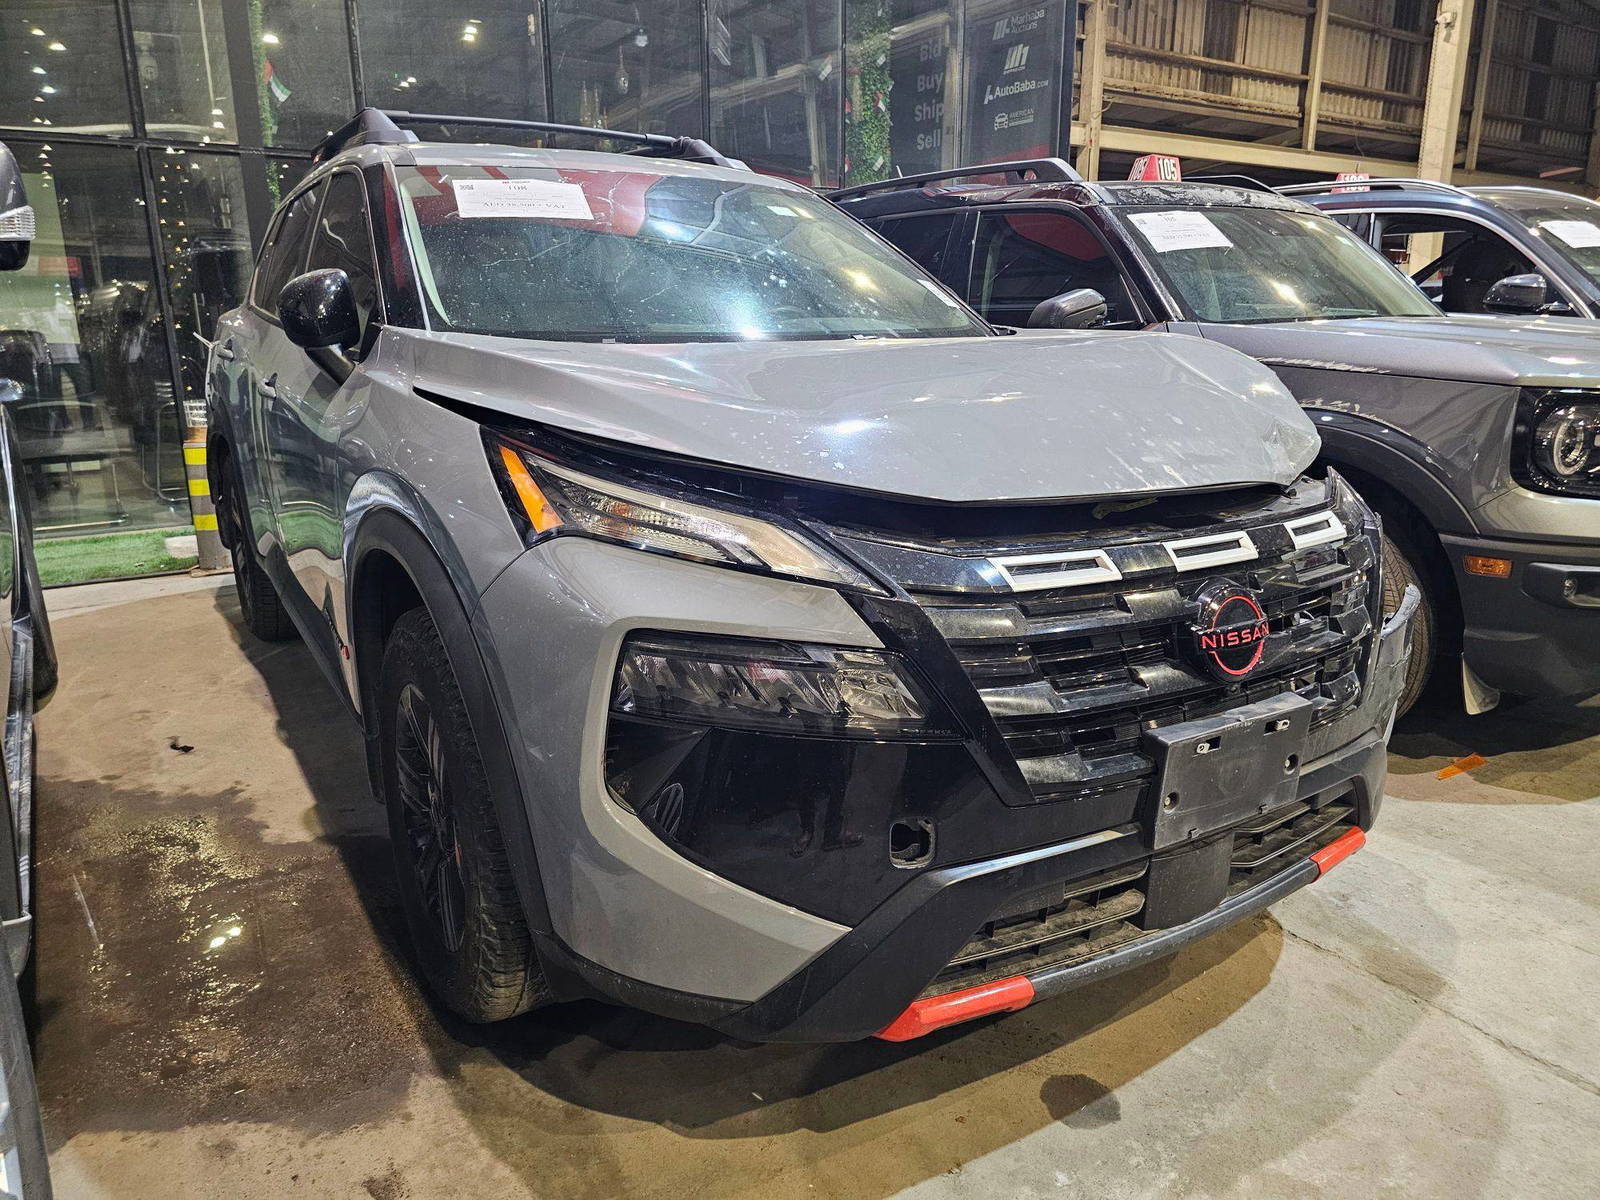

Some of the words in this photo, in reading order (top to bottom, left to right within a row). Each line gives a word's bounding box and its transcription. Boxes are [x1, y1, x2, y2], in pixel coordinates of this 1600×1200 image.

[1011, 9, 1045, 26] Marhaba
[920, 38, 942, 62] Bid
[917, 72, 944, 93] Buy
[914, 100, 944, 123] Ship
[916, 129, 941, 151] Sell
[1158, 158, 1179, 182] 105
[1201, 623, 1270, 649] NISSAN
